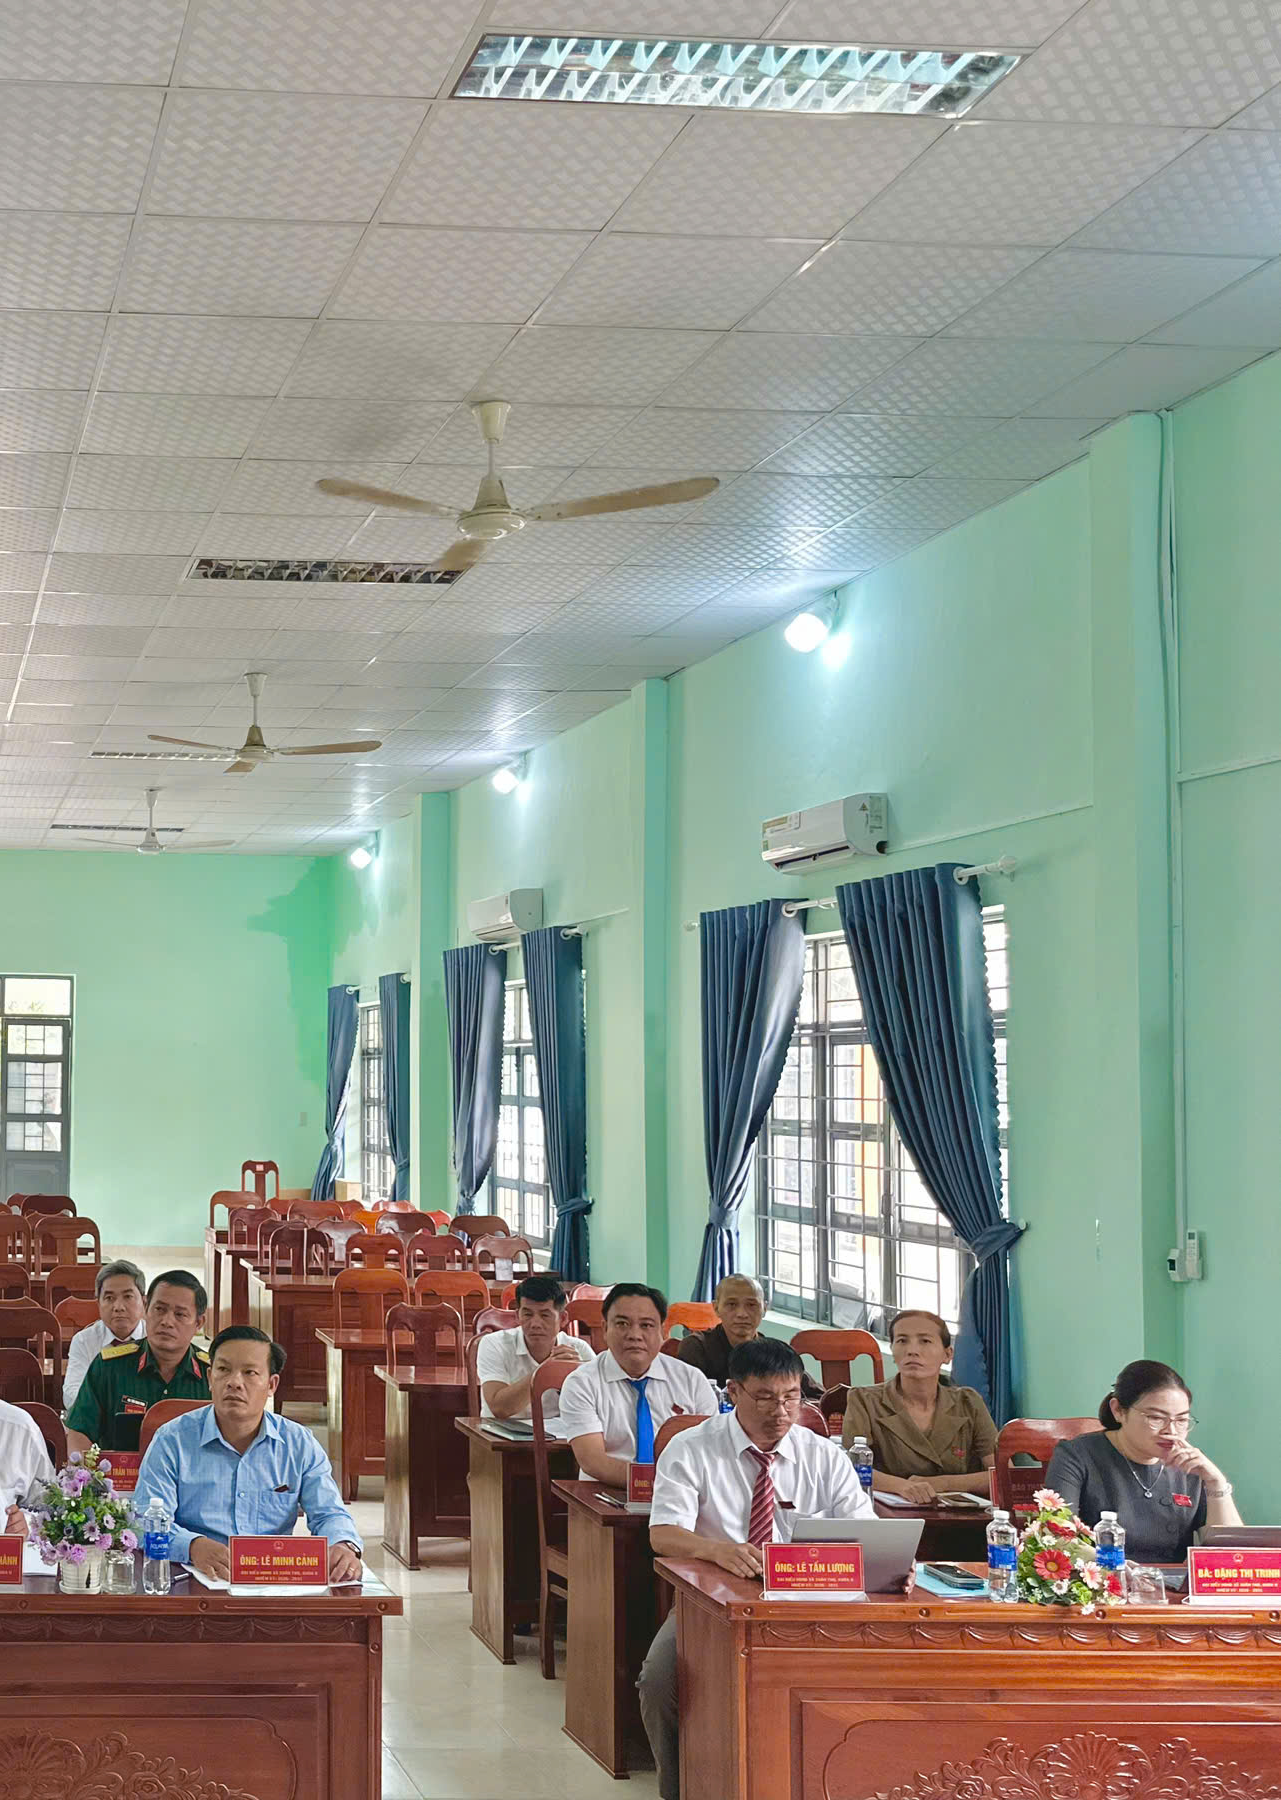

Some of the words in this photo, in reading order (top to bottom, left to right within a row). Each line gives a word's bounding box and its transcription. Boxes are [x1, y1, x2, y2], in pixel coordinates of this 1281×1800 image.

[239, 1554, 259, 1566] ÔNG:
[261, 1554, 271, 1566] LÊ
[272, 1556, 295, 1566] MINH
[774, 1561, 795, 1573] ÔNG:
[796, 1561, 807, 1573] LÊ
[808, 1560, 825, 1573] TẤN
[826, 1562, 855, 1575] LƯỢNG
[1197, 1566, 1213, 1578] BÀ:
[1214, 1567, 1238, 1580] ĐẶNG
[1239, 1568, 1253, 1580] THỊ
[1254, 1568, 1280, 1578] TRINH
